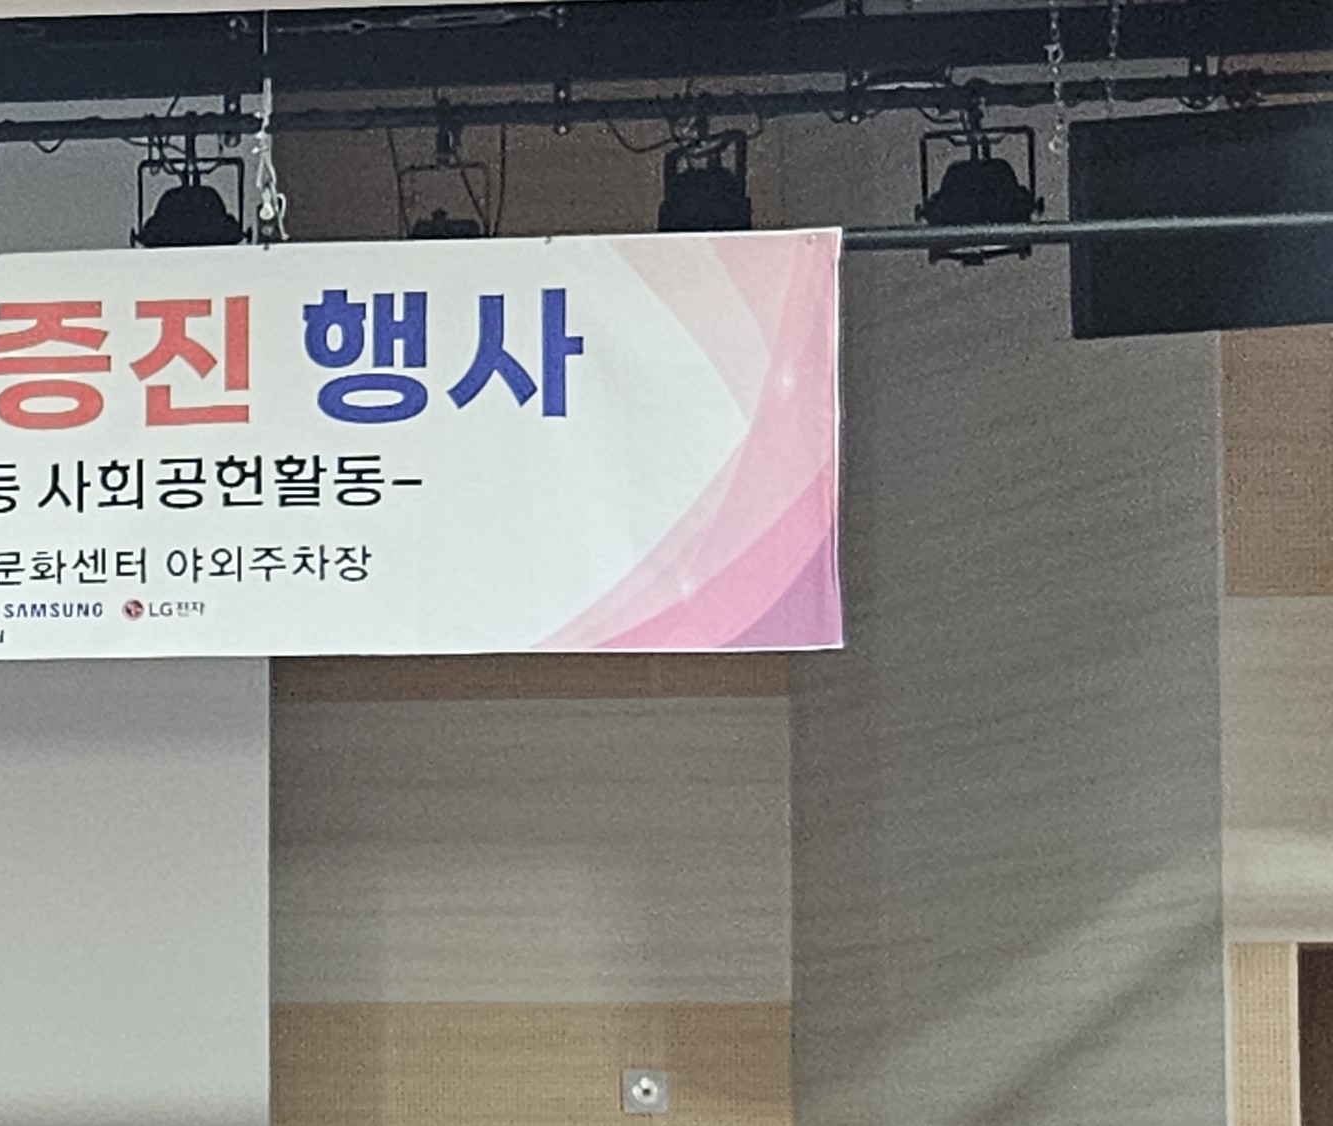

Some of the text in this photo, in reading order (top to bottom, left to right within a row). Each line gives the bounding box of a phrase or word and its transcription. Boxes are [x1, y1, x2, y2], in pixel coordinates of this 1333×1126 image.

[302, 288, 584, 424] 행사
[166, 544, 372, 584] 야외주차장
[4, 602, 103, 619] SAMSUNG
[149, 602, 205, 617] LG전자
